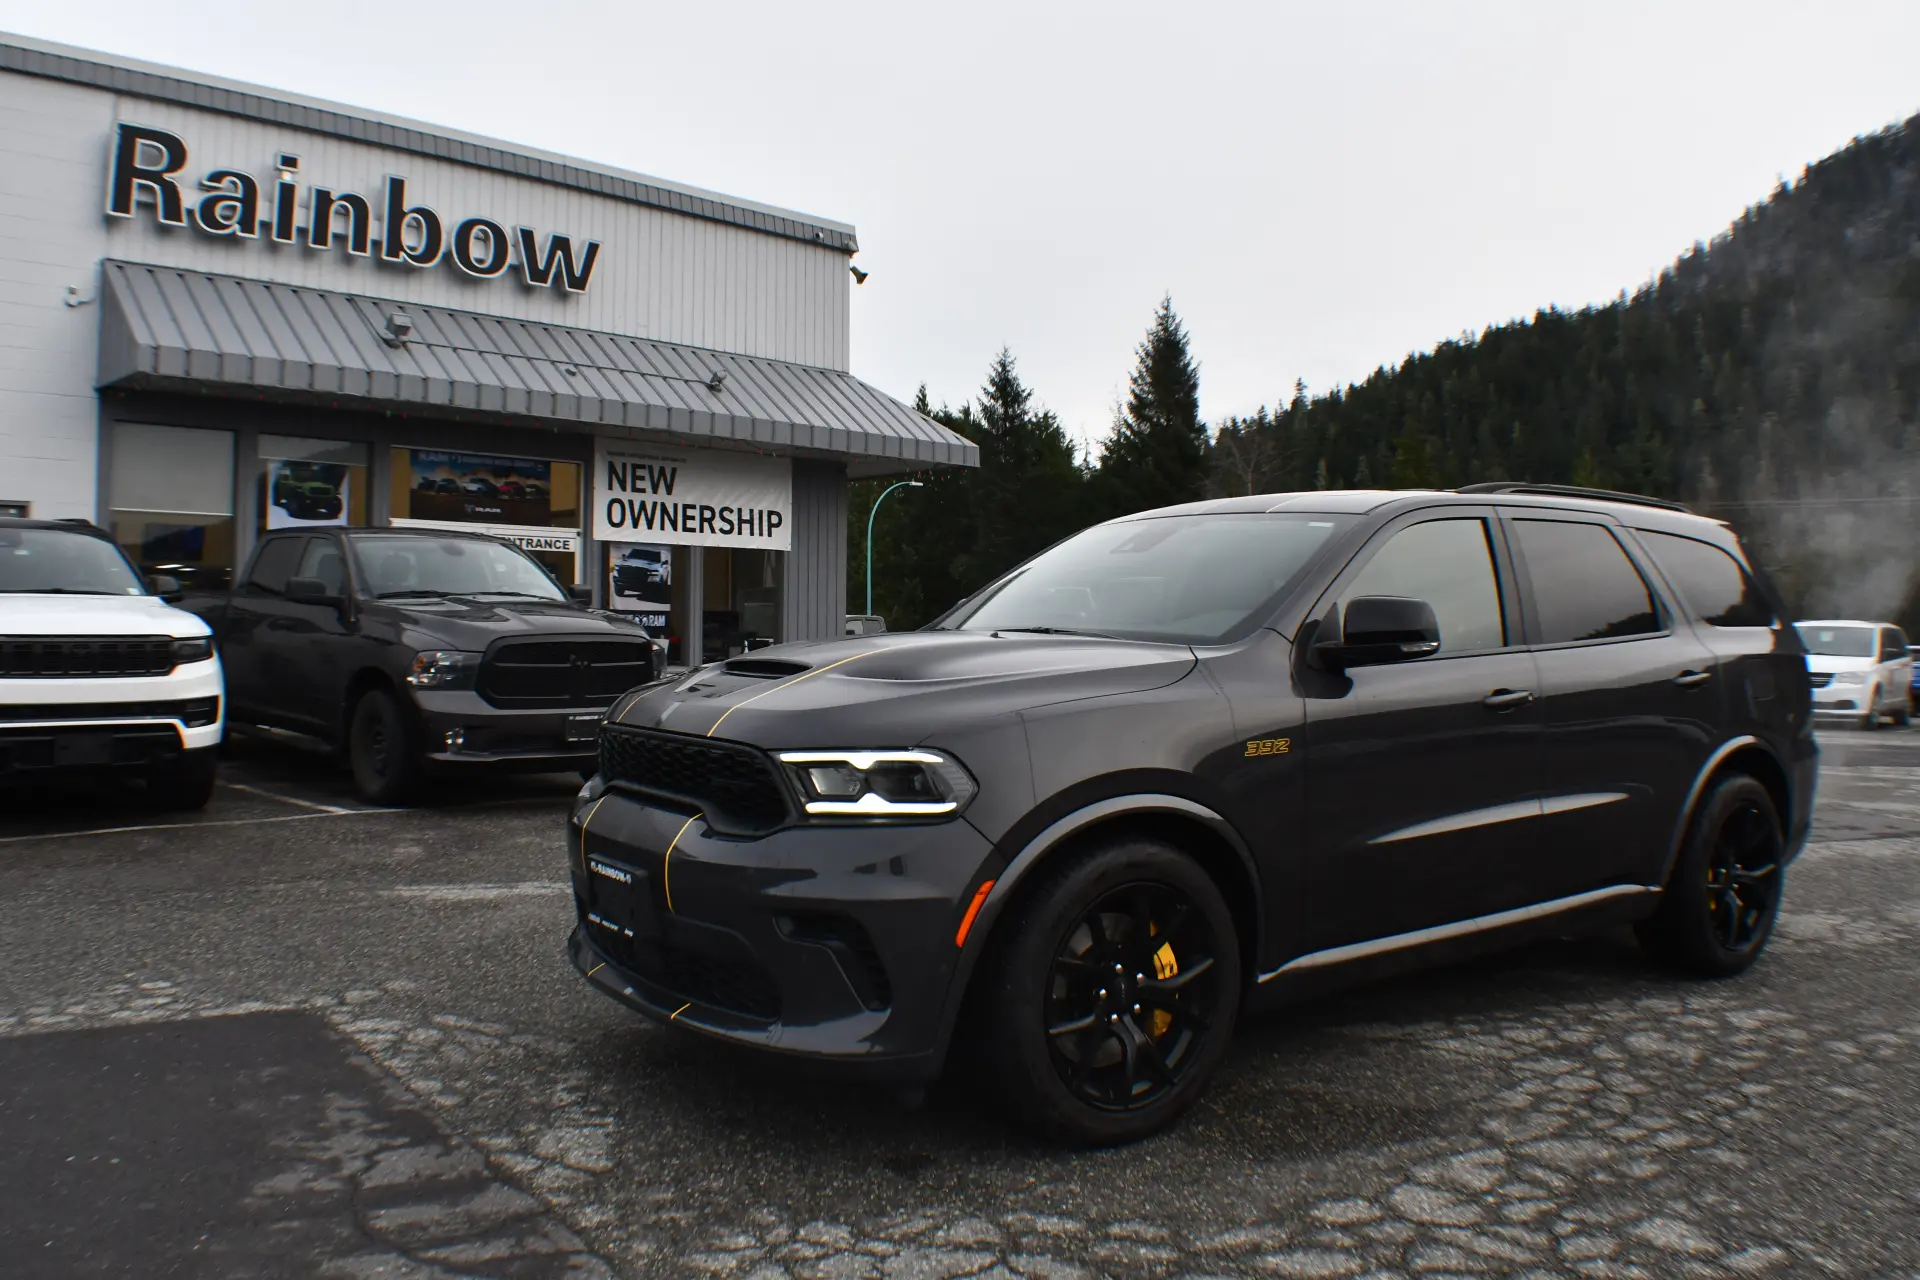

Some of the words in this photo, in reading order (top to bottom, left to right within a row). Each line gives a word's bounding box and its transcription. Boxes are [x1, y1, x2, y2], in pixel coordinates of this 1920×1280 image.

[108, 121, 601, 292] Rainbow
[607, 460, 677, 496] NEW
[606, 498, 783, 538] OWNERSHIP
[509, 537, 570, 550] NTRANCE
[648, 614, 666, 627] RAM
[1245, 738, 1290, 757] 392
